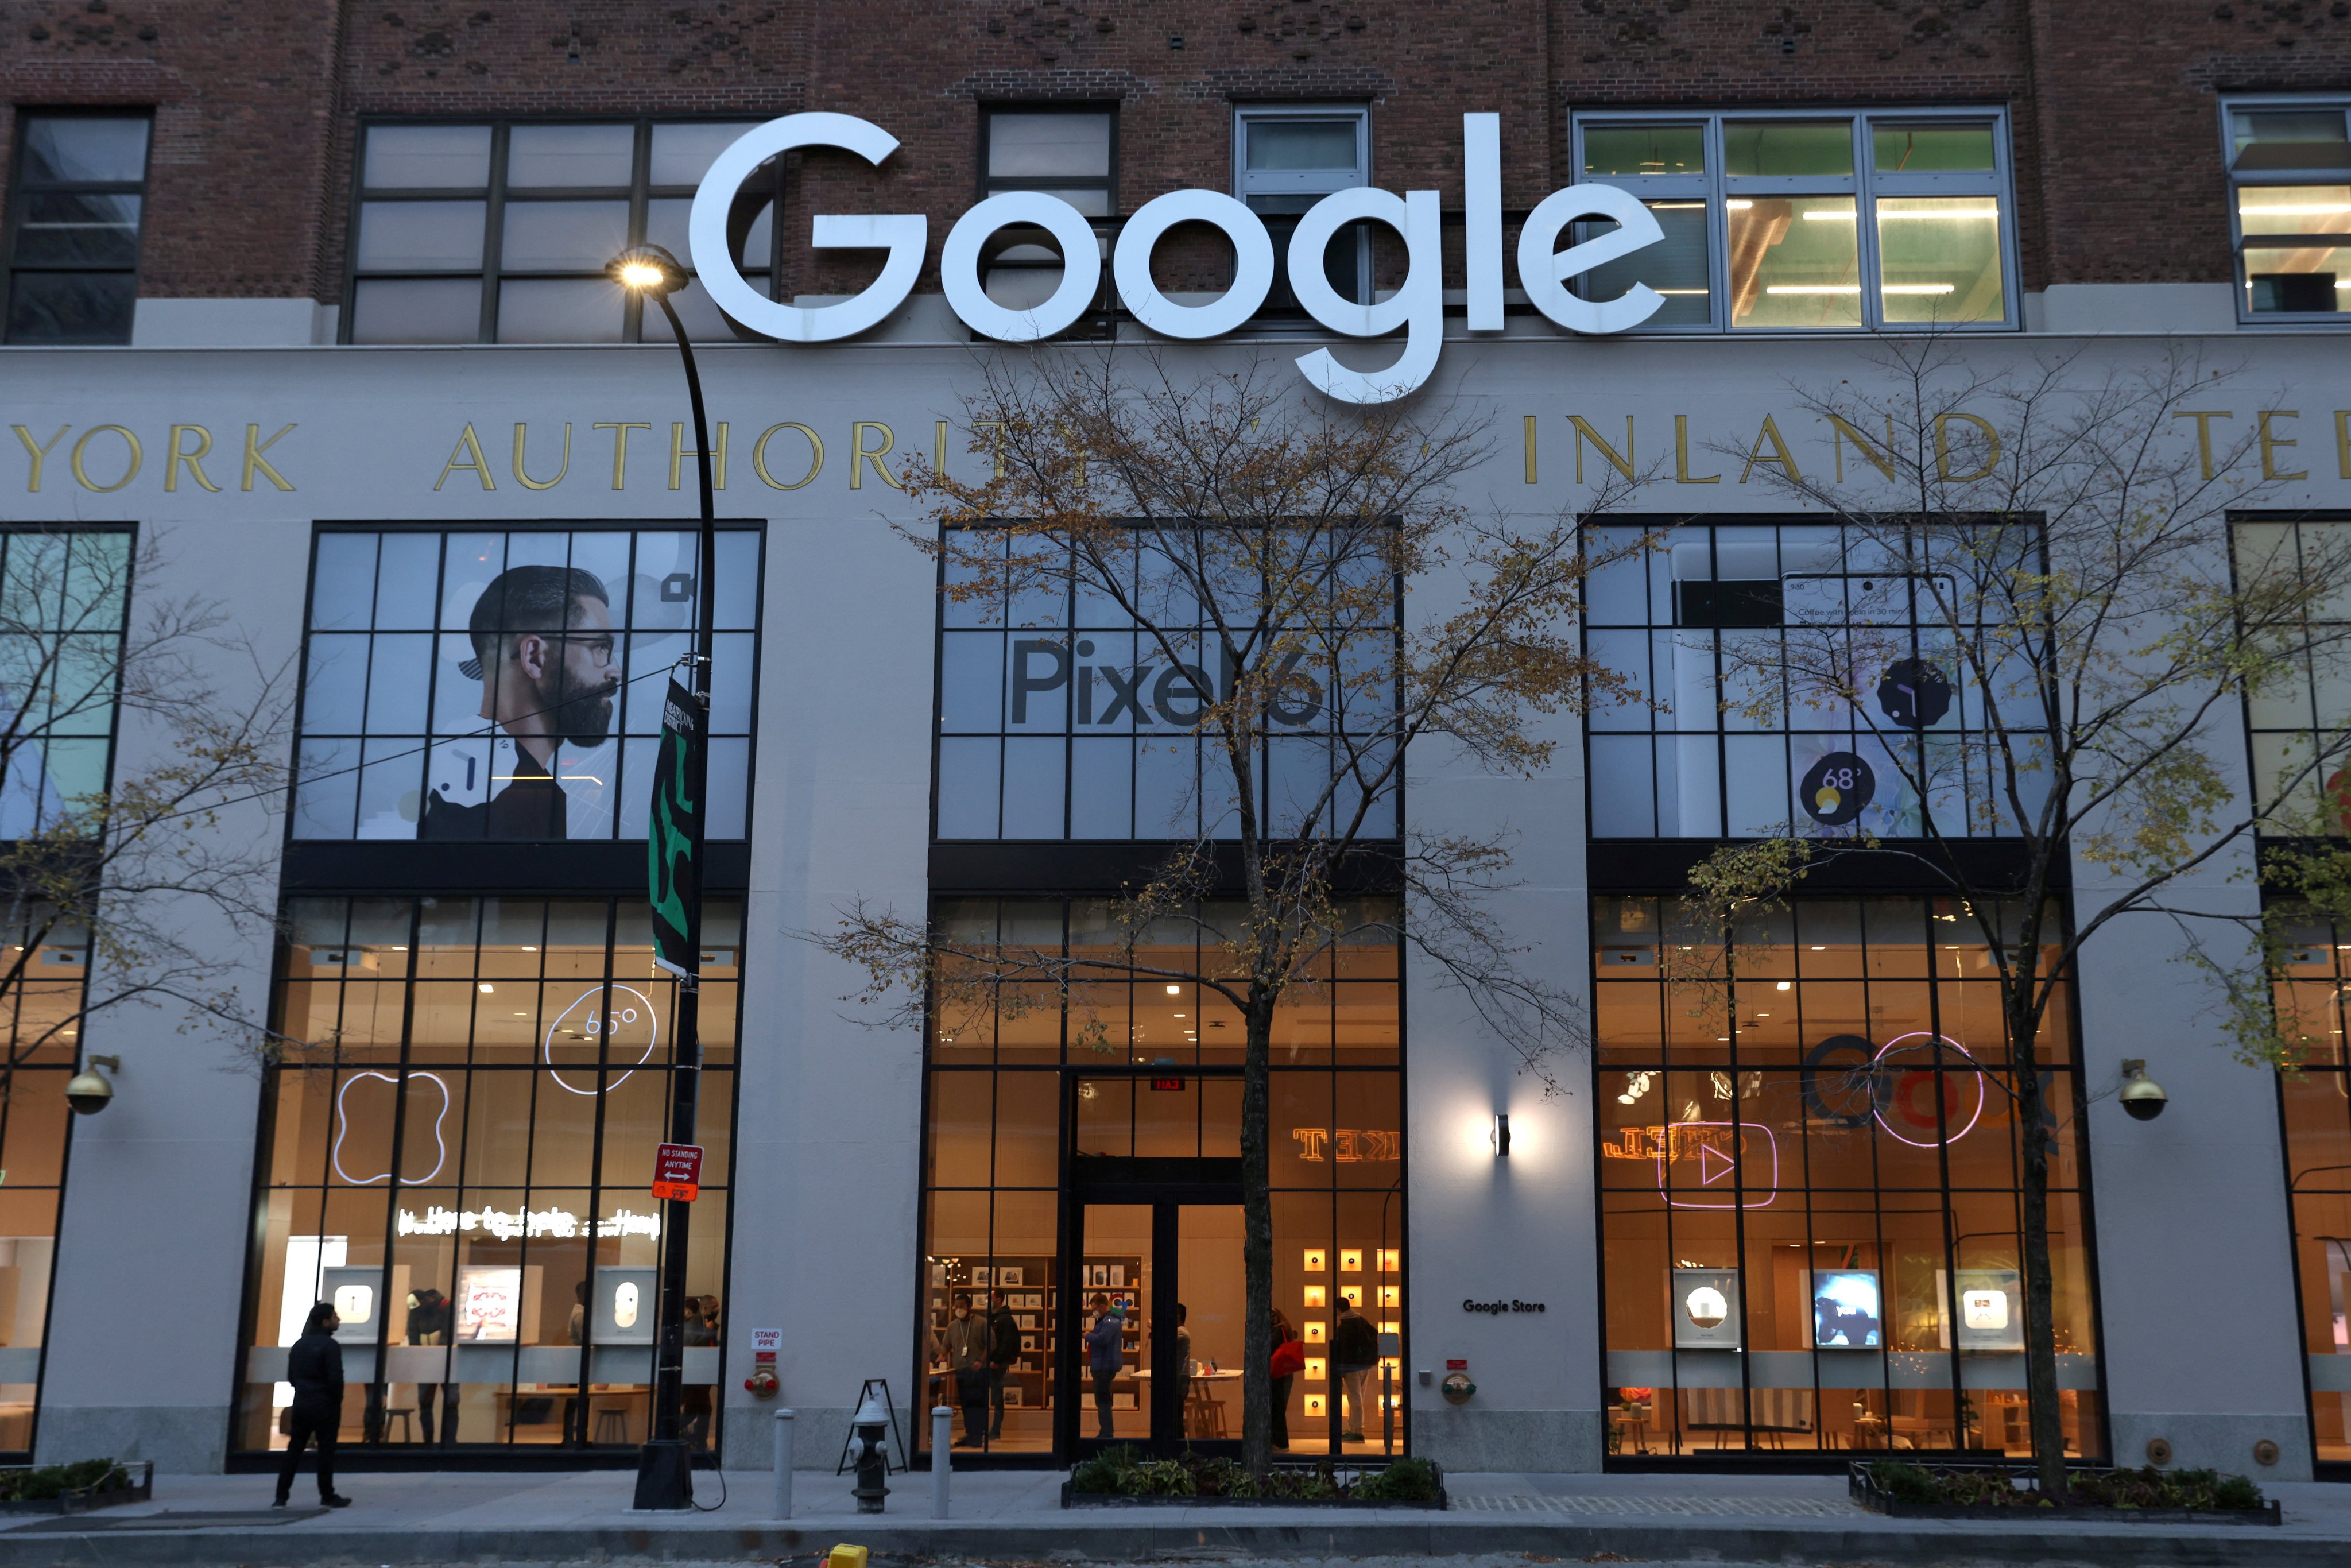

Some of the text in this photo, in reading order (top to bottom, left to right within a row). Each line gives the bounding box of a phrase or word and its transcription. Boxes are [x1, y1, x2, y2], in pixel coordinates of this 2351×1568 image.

[690, 111, 1667, 405] Google
[11, 420, 1109, 493] YORK AUTHORITY
[1524, 413, 2002, 485] INLAND
[1798, 608, 1825, 616] Coffee
[1012, 638, 1323, 727] Pixel 6
[664, 711, 683, 734] DISTRICT
[671, 1150, 698, 1159] STANDING
[665, 1160, 692, 1170] ANYTIME
[1463, 1300, 1545, 1314] Google Store
[1835, 1306, 1856, 1317] you
